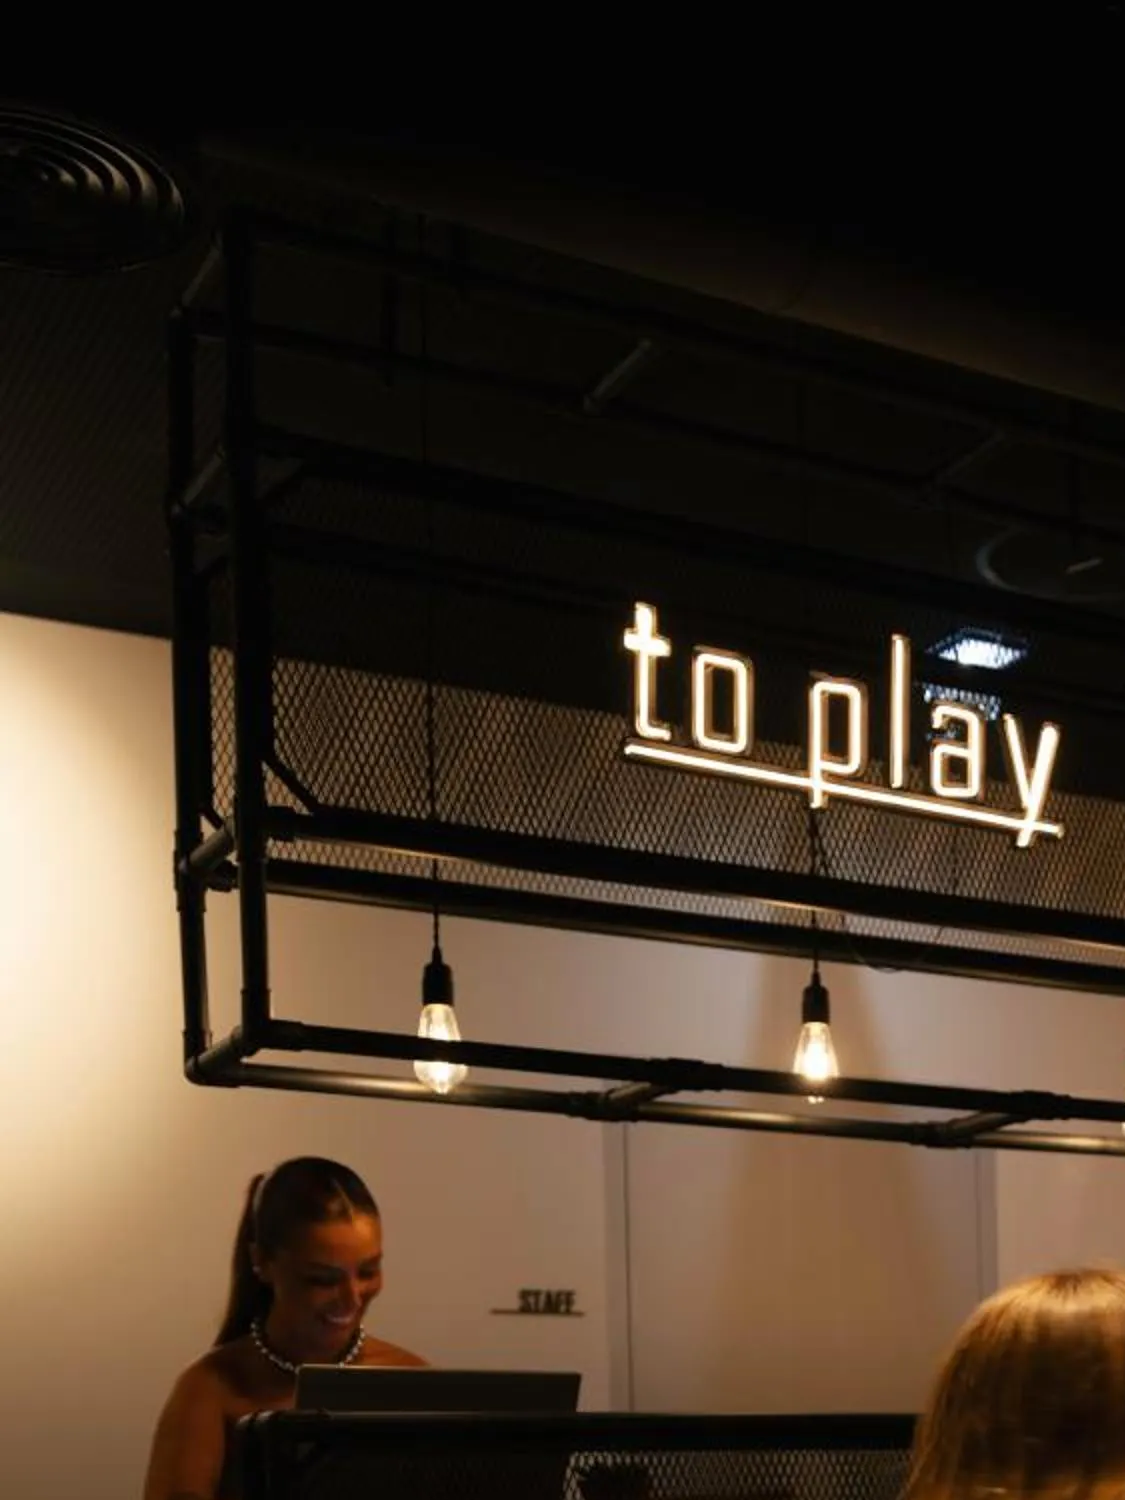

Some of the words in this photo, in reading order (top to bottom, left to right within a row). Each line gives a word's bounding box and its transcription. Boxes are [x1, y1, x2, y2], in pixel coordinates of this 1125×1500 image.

[623, 602, 754, 753] to
[808, 633, 1059, 848] play
[518, 1288, 576, 1314] STAFF
